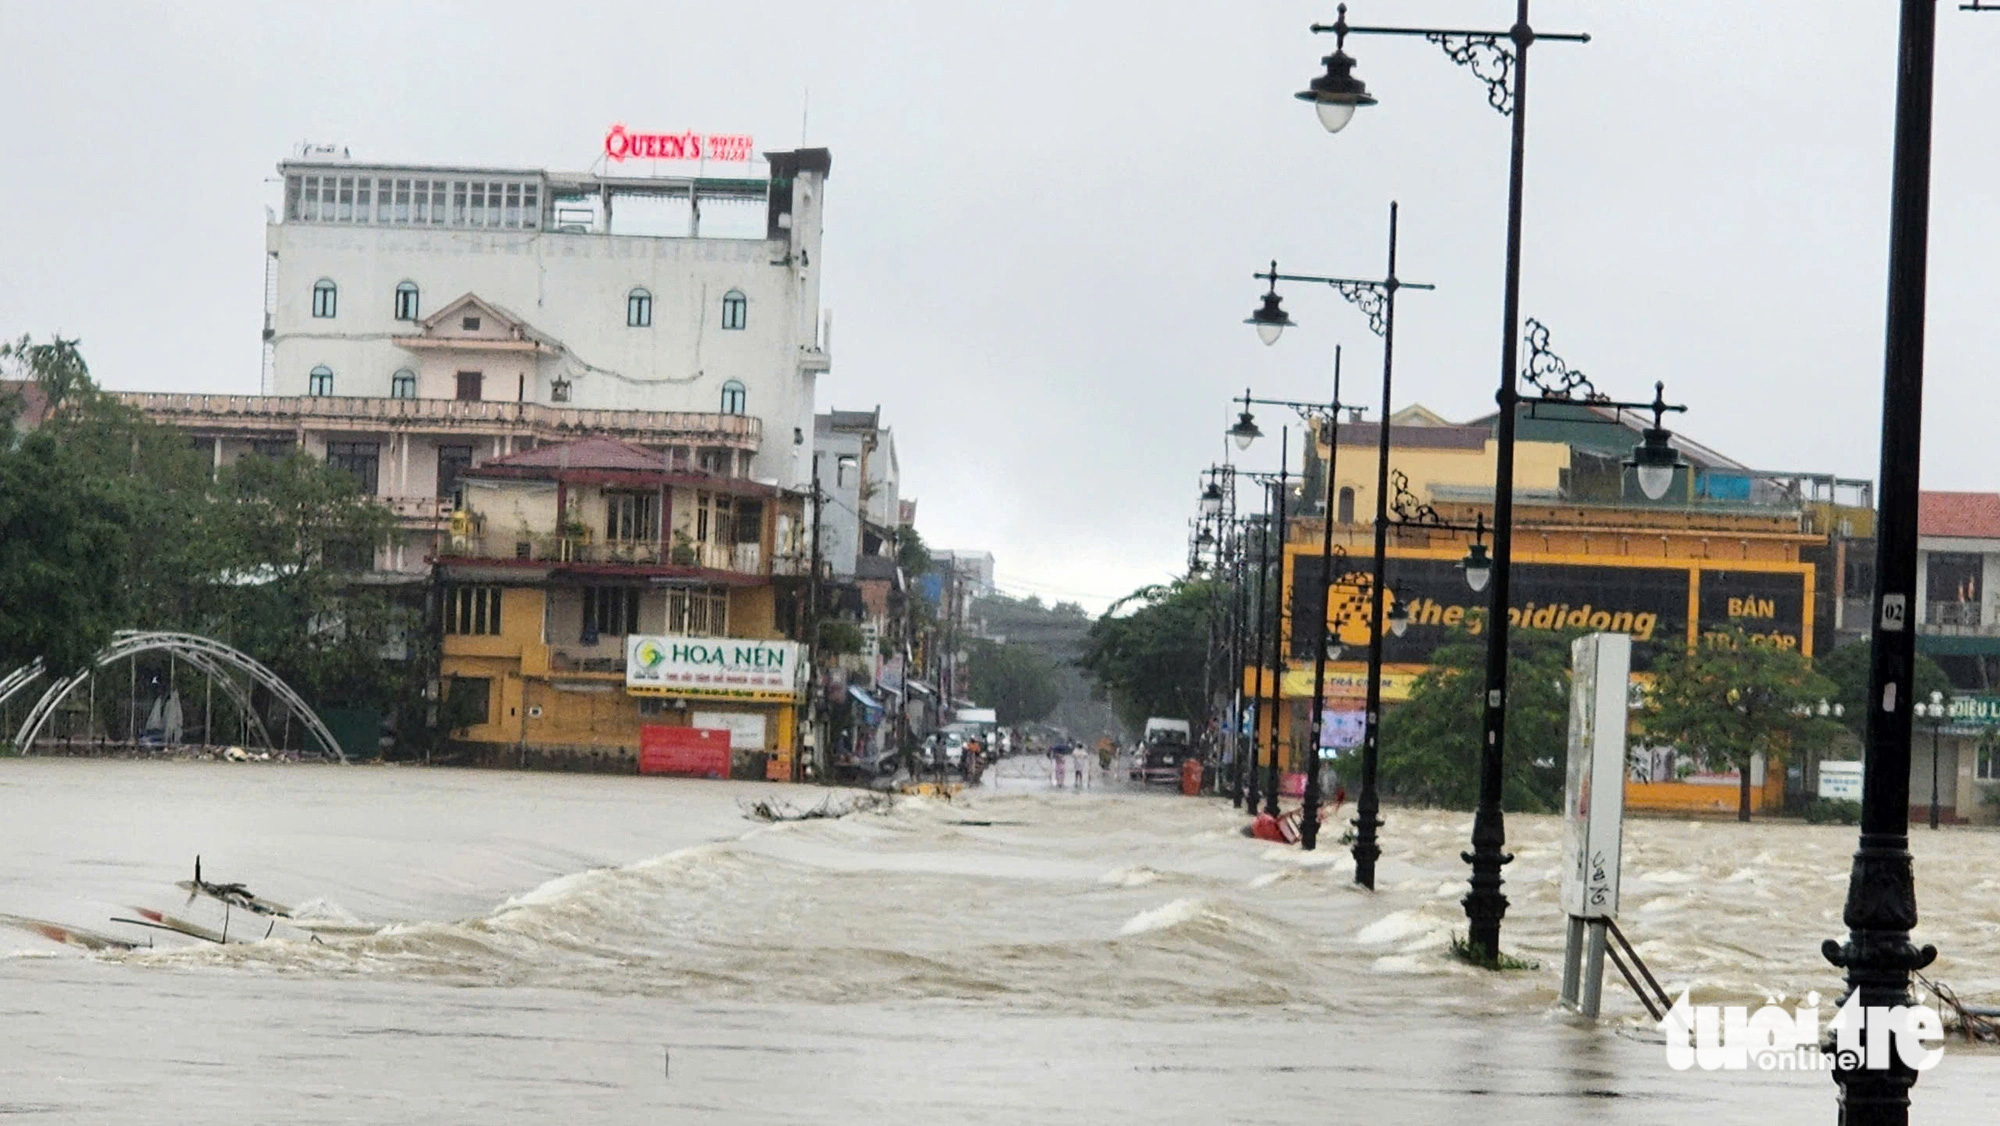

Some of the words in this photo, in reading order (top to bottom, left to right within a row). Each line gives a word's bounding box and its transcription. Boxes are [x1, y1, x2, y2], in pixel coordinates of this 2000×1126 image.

[606, 127, 701, 162] QUEEN'S
[1727, 594, 1775, 619] BÁN
[1885, 603, 1903, 621] 02
[1407, 598, 1657, 641] thegoididong
[672, 643, 725, 666] HOA
